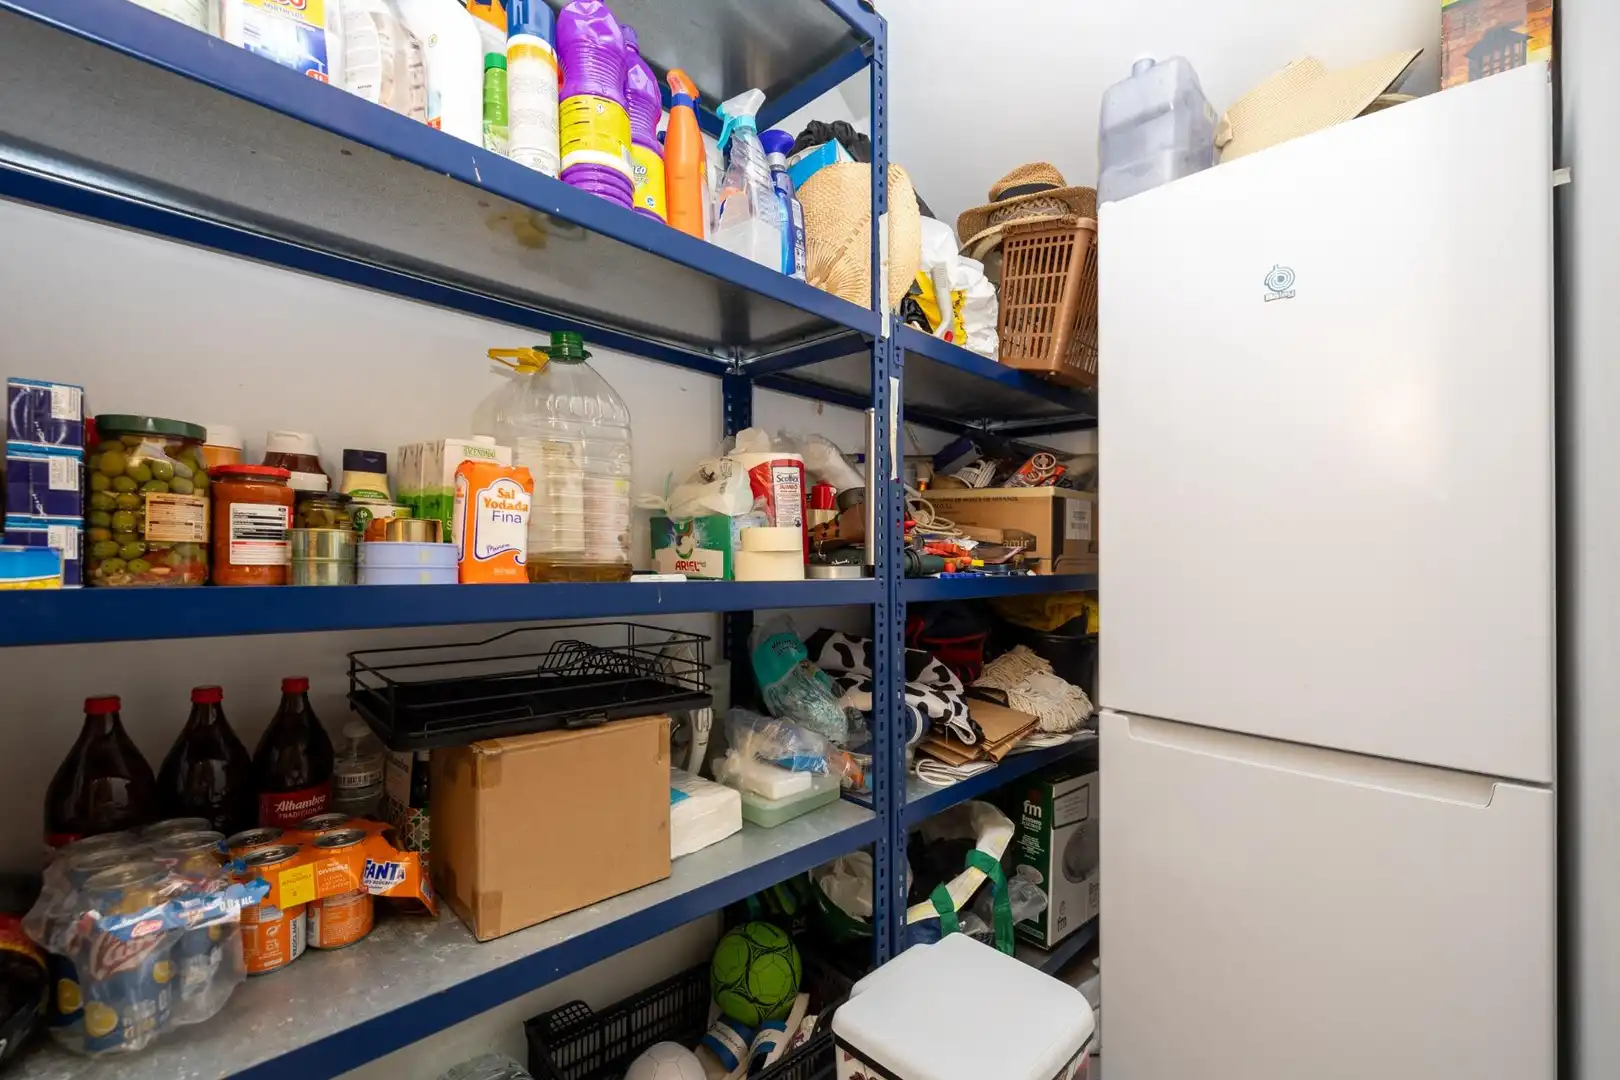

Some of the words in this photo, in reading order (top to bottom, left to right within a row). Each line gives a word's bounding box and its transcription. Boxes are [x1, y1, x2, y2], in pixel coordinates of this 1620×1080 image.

[497, 487, 515, 499] Sal
[483, 497, 528, 512] Yodada
[492, 510, 522, 523] Fina
[675, 560, 700, 572] ARIEL
[274, 794, 326, 812] Alhambra
[1023, 799, 1042, 818] fm
[364, 859, 405, 880] FANTA
